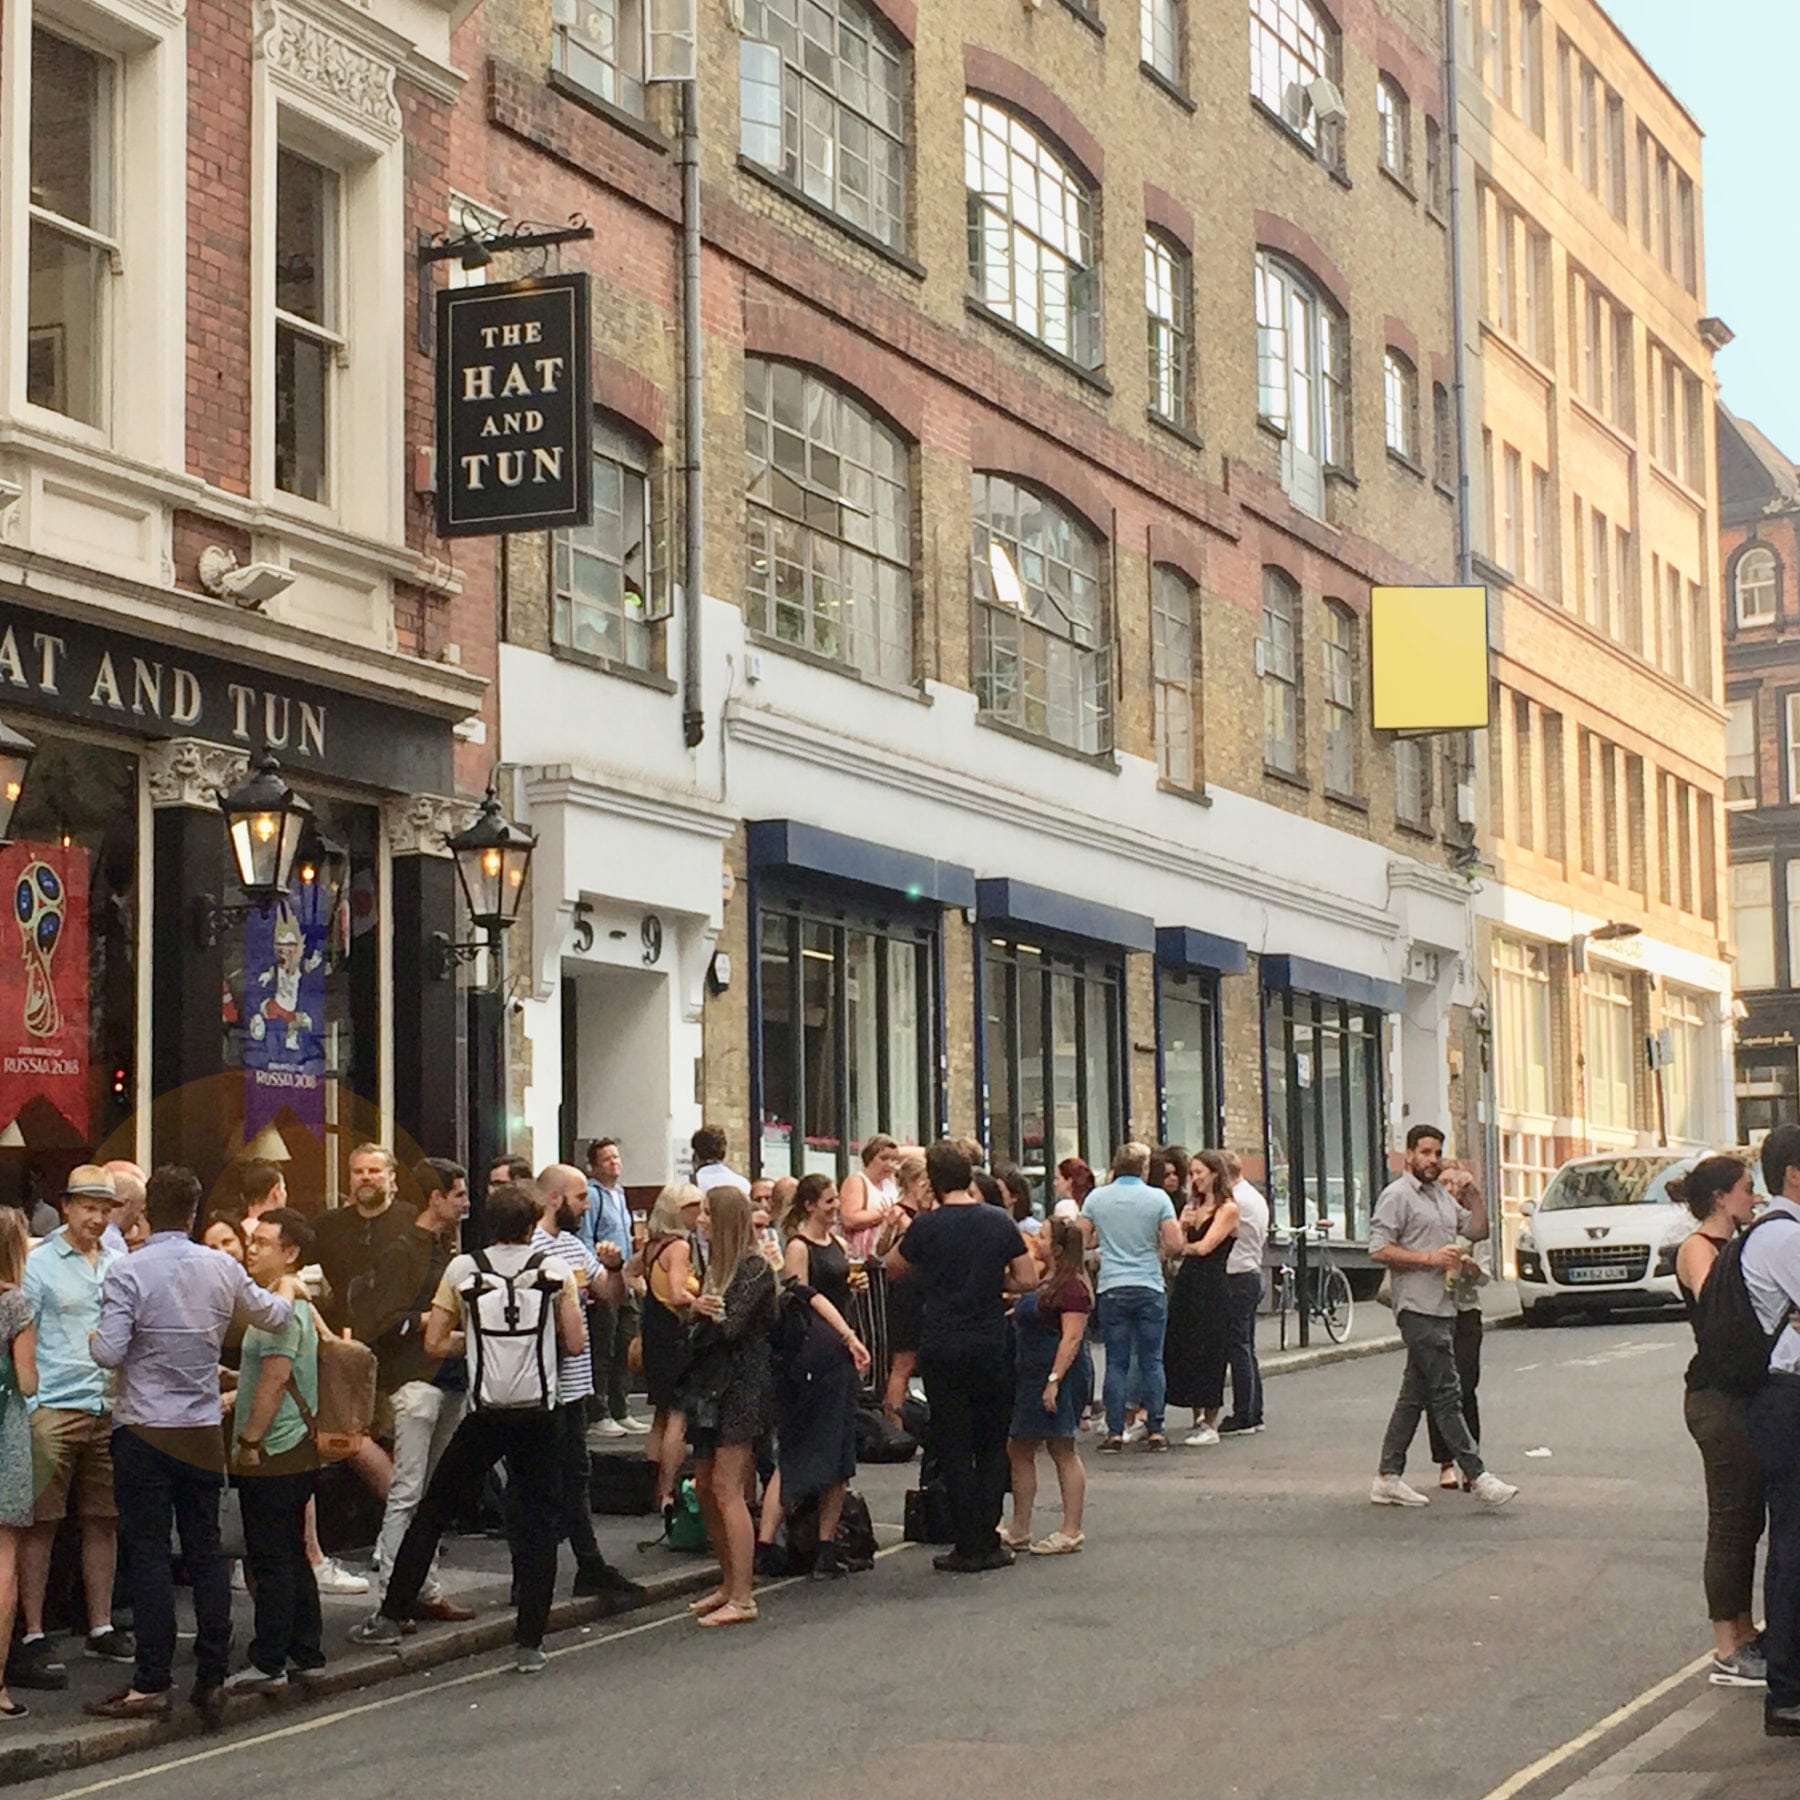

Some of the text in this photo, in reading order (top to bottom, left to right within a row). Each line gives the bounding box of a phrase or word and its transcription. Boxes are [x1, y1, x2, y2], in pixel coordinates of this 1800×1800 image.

[481, 321, 543, 349] THE
[462, 357, 565, 401] HAT
[480, 410, 545, 437] AND
[461, 446, 565, 490] TUN
[89, 651, 202, 726] AND
[228, 683, 327, 758] TUN
[4, 1057, 79, 1075] RUSSIA 2018
[255, 1070, 317, 1089] RUSSIA 2018
